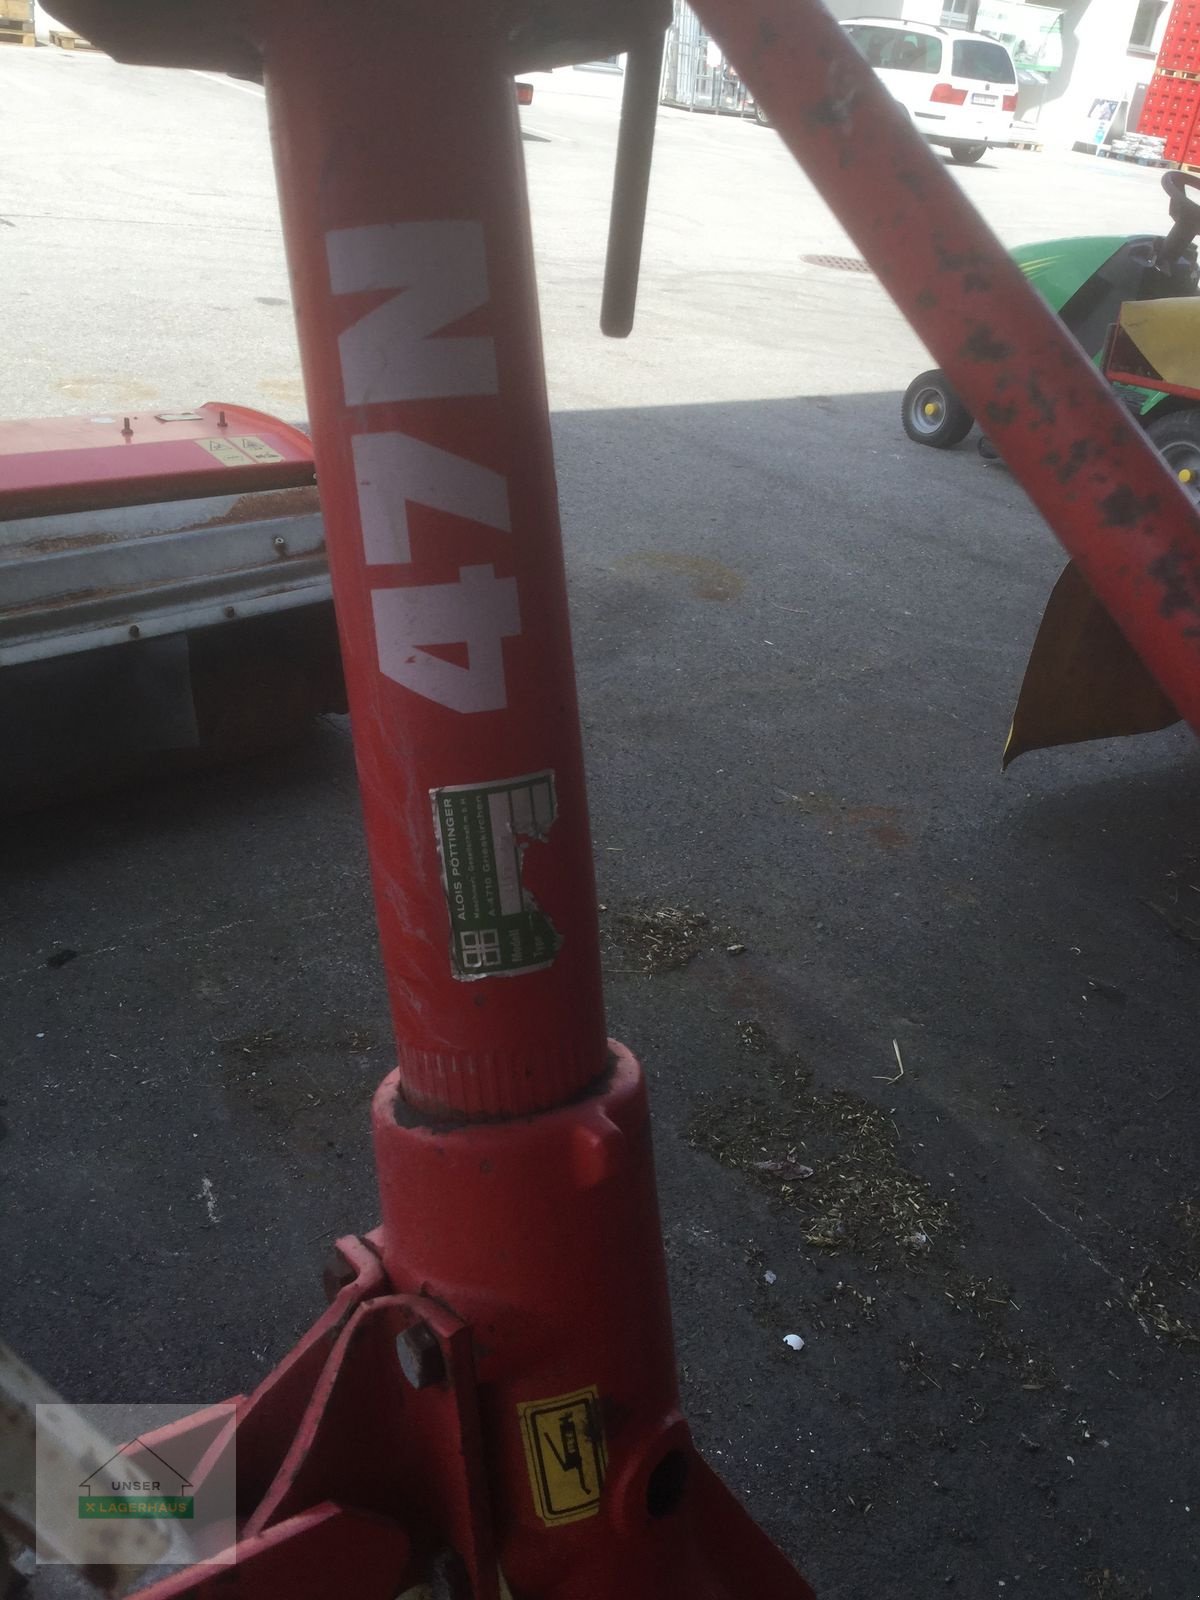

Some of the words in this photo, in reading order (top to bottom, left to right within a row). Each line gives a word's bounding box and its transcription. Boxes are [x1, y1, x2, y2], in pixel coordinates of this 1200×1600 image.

[325, 220, 522, 714] 47N
[443, 798, 460, 877] PÖTTINGER
[475, 796, 490, 872] Grieskirchen
[454, 882, 466, 921] ALOIS
[509, 929, 523, 962] Modell
